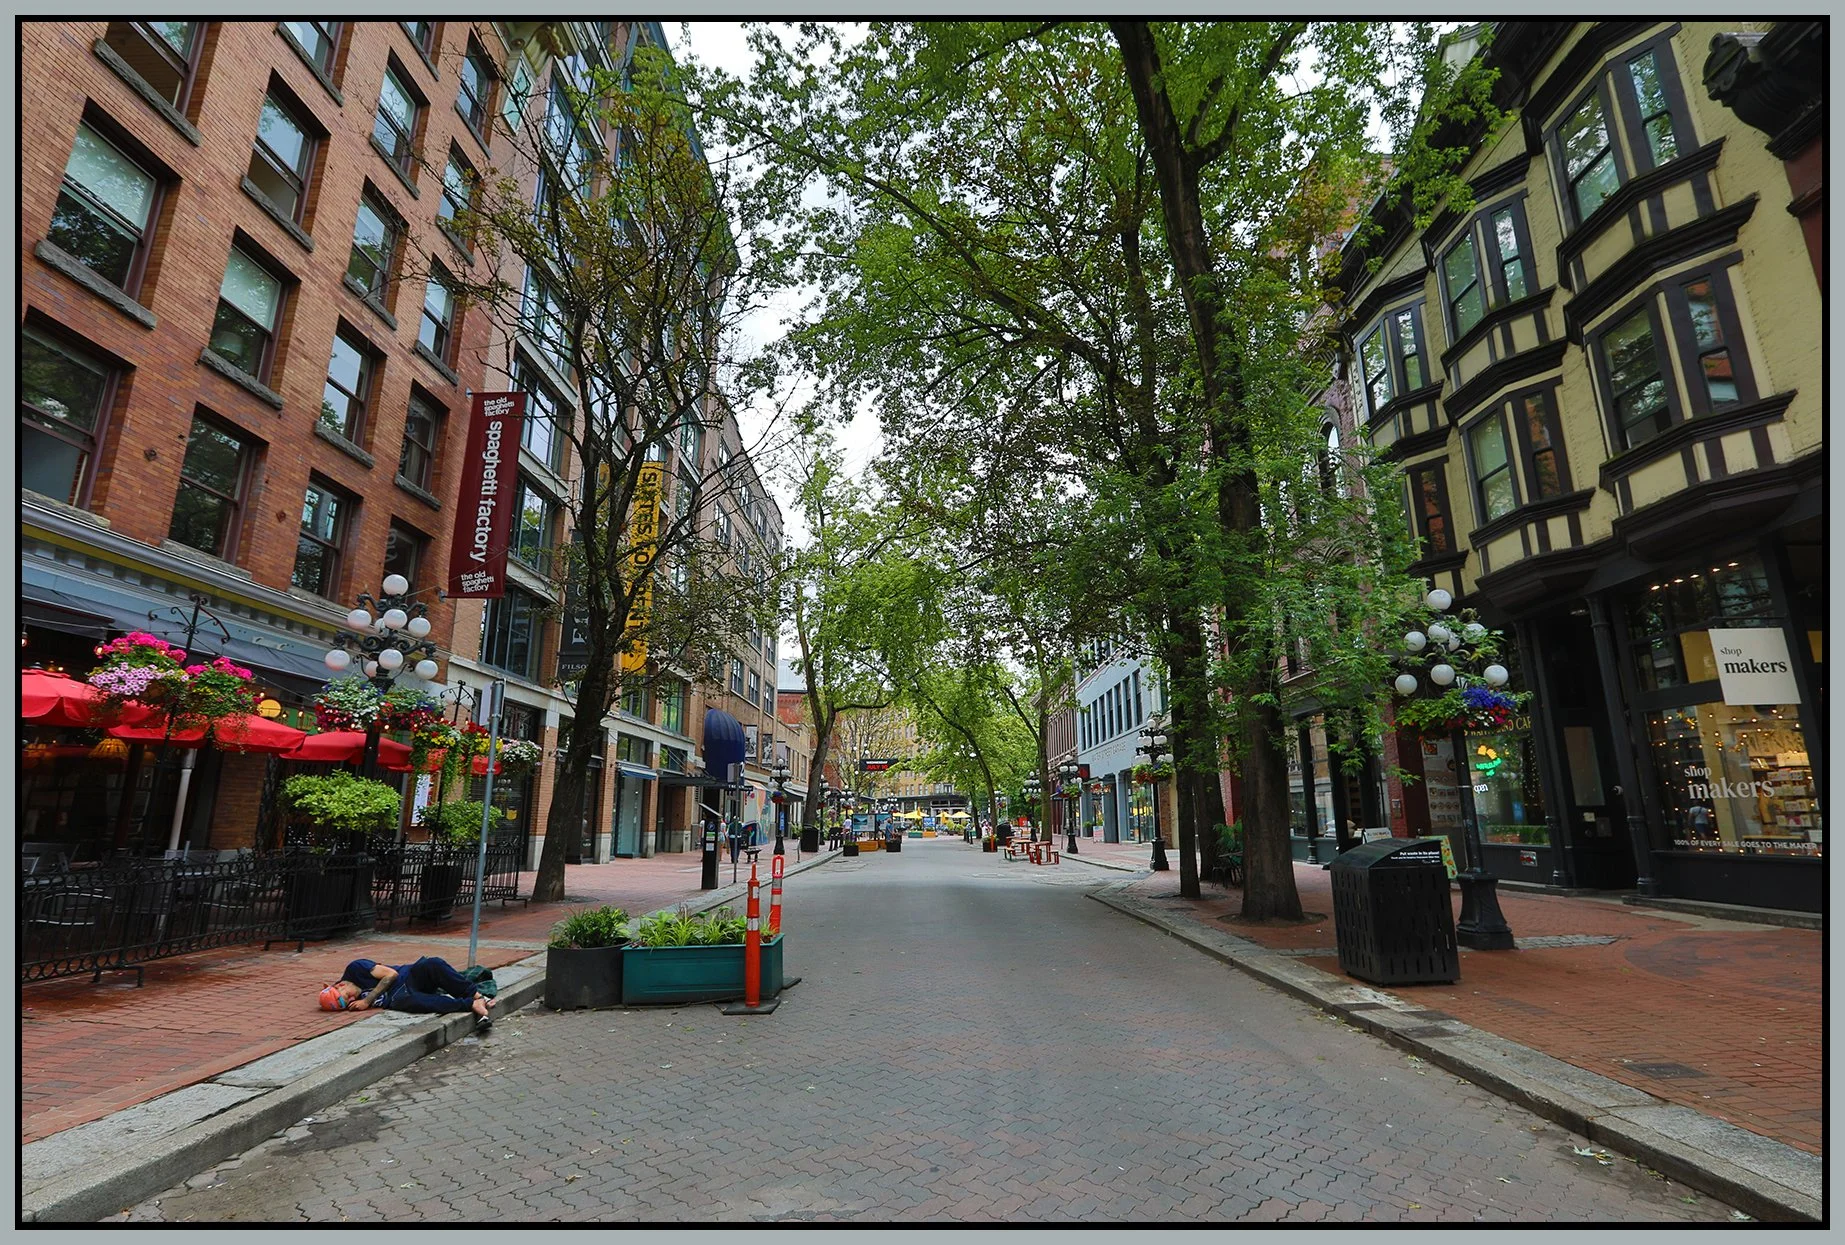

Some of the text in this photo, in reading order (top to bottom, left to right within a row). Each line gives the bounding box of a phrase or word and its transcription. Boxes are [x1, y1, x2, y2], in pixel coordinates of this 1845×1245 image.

[496, 396, 507, 404] old
[484, 401, 515, 411] spaghetti
[485, 408, 510, 416] factory
[469, 420, 502, 563] spaghetti factory
[638, 472, 657, 535] STES
[461, 570, 486, 581] the old
[462, 576, 495, 588] spaghetti
[463, 583, 489, 593] factory
[1720, 647, 1742, 657] shop
[1724, 658, 1788, 674] makers
[1516, 716, 1532, 730] CAF
[1684, 765, 1712, 779] shop
[1687, 777, 1775, 800] makers
[1789, 842, 1818, 850] MAKER
